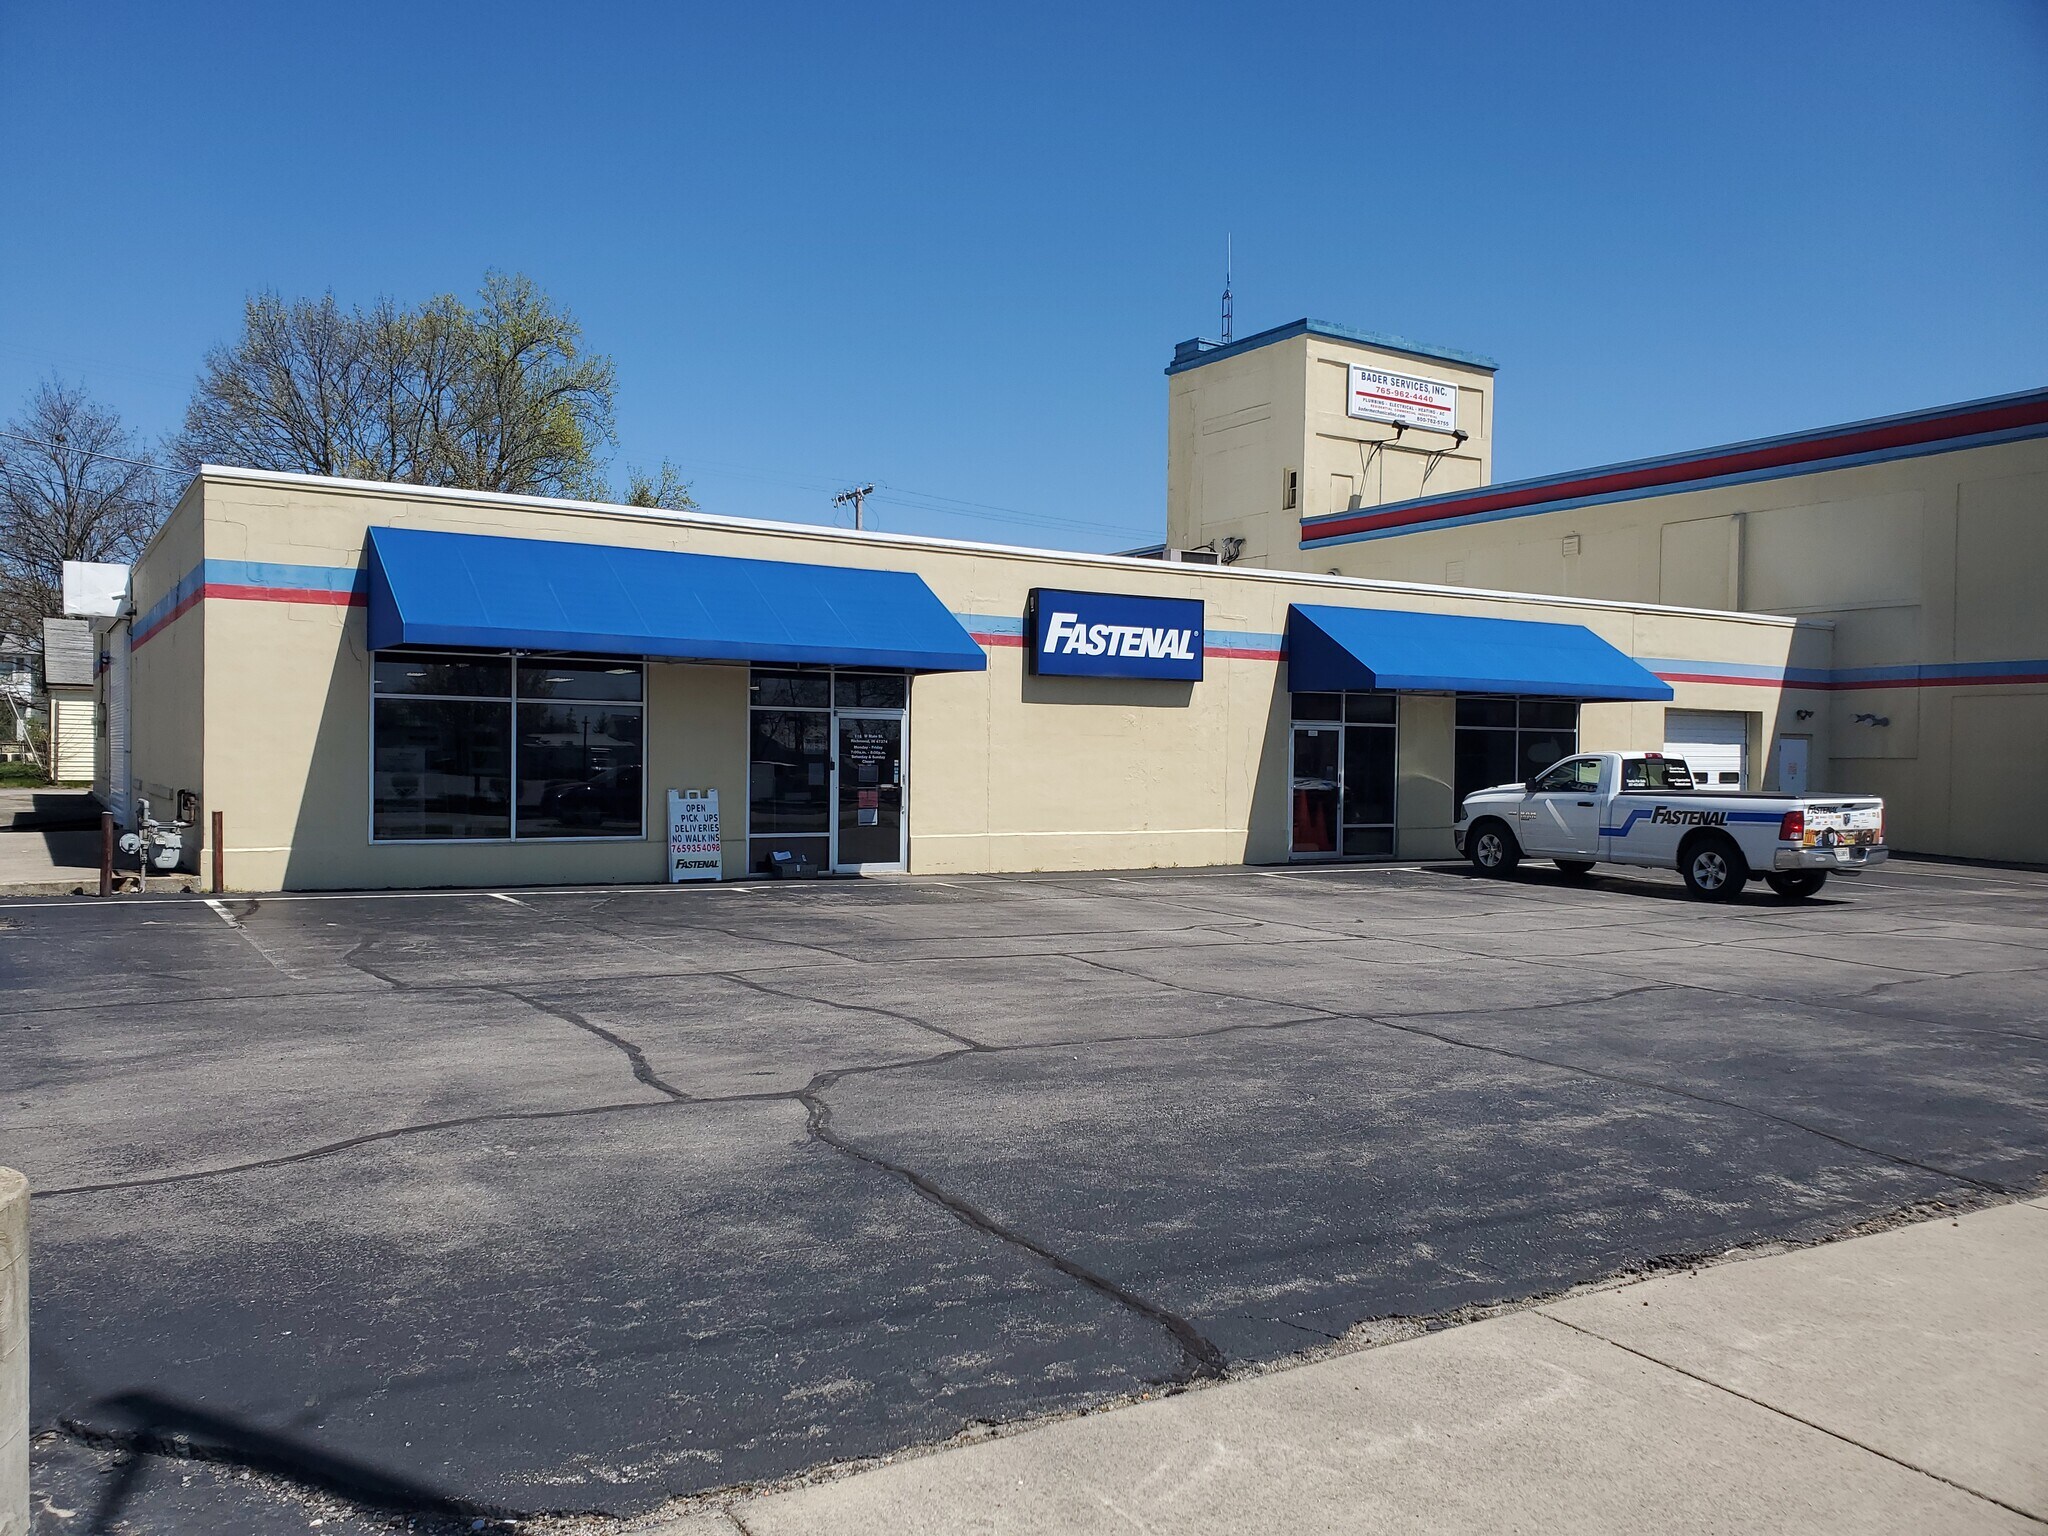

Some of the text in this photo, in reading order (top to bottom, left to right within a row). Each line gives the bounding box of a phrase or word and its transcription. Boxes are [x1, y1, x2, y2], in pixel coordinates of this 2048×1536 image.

[1361, 371, 1448, 397] BADER SERVICES, INC.
[1376, 386, 1434, 403] 765-962-4440
[1362, 398, 1385, 406] PLUMBING
[1389, 402, 1414, 411] ELECTRICAL
[1418, 407, 1436, 415] HEATING
[1043, 612, 1195, 660] FASTENAL
[686, 804, 706, 813] OPEN
[1806, 804, 1839, 815] FASTENAL
[681, 813, 718, 823] PICK UPS
[1651, 805, 1728, 827] FASTENAL
[675, 823, 720, 833] DELIVERIES
[672, 833, 720, 843] NO WALK INS
[672, 844, 720, 853] 7659354098
[675, 859, 720, 869] FASTENAL
